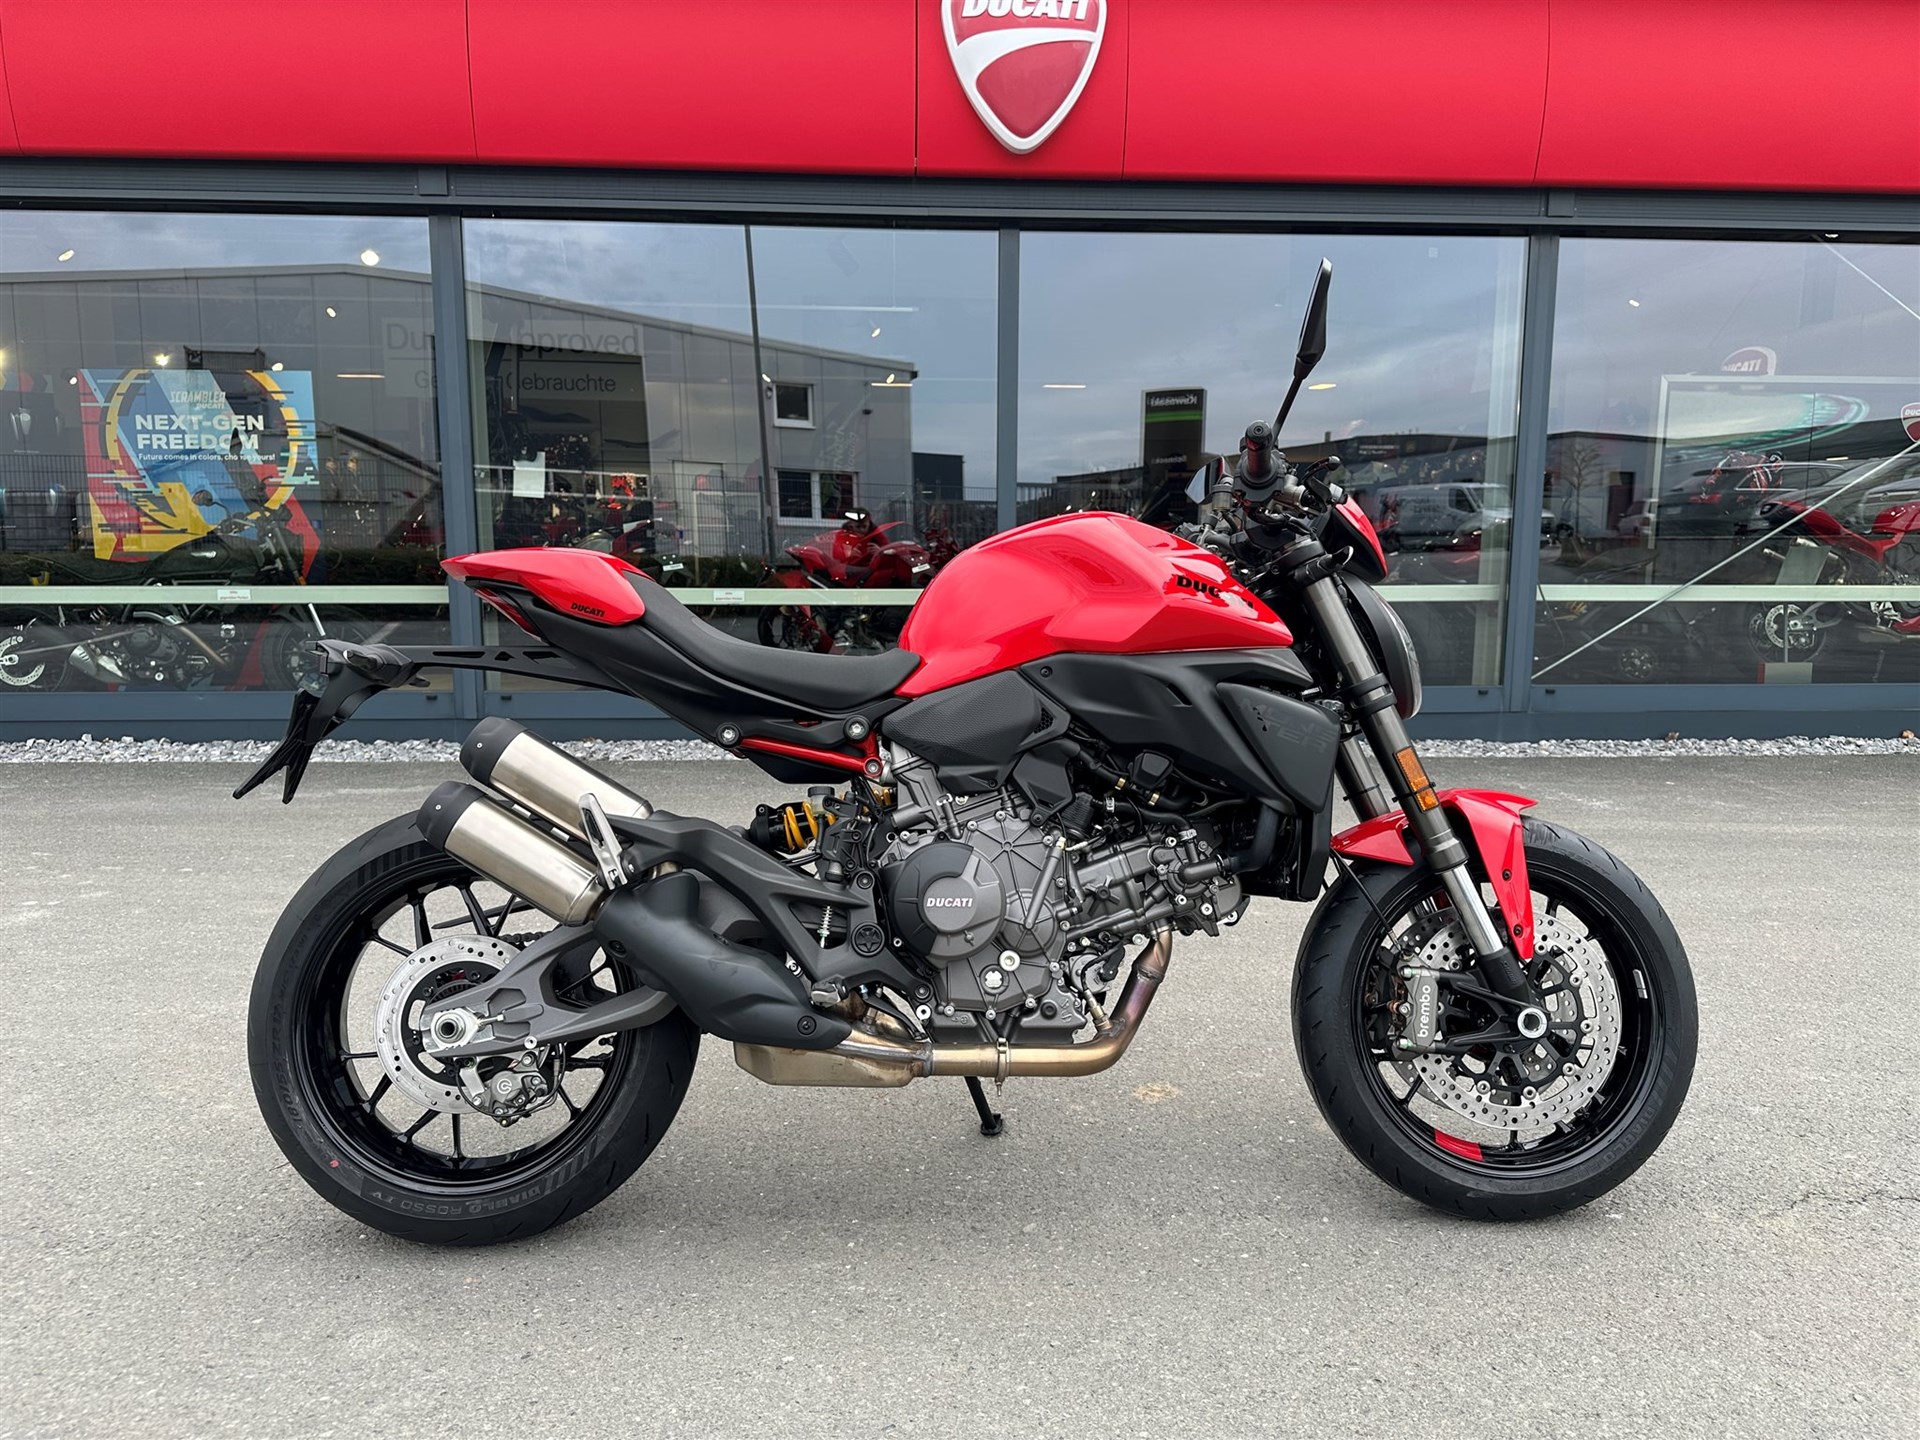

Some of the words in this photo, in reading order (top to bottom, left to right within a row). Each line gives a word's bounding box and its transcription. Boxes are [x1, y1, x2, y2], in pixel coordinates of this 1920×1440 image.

[961, 0, 1090, 20] DUCATI
[516, 325, 639, 359] pproved
[170, 391, 226, 403] SCRAMBLER
[135, 414, 265, 431] NEXT-GEN
[138, 453, 163, 461] Future
[164, 453, 188, 461] comes
[189, 452, 197, 461] in
[198, 452, 223, 462] colors,
[1176, 574, 1255, 609] DUCI
[570, 602, 606, 618] DUCATI
[926, 897, 974, 908] DUCATI
[1417, 984, 1432, 1039] brembo
[400, 1200, 463, 1215] ROSSO
[466, 1187, 542, 1214] DIABLO
